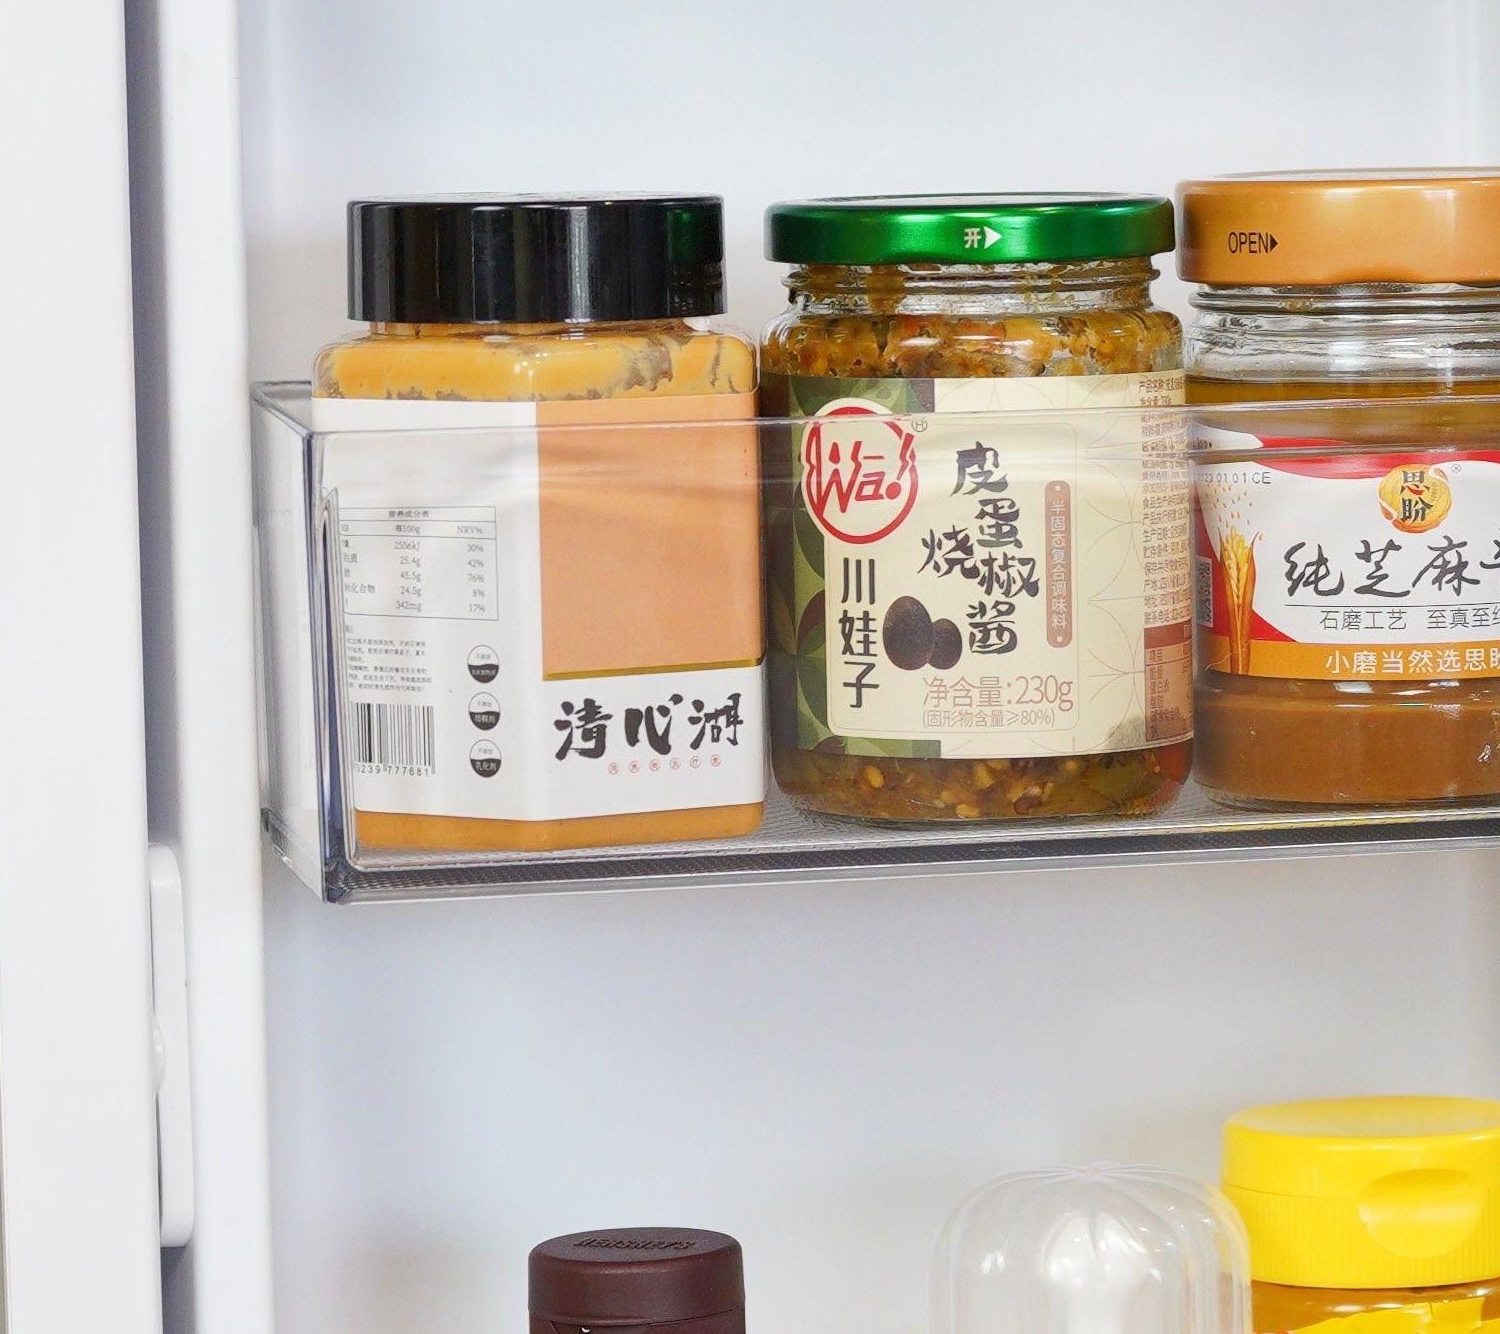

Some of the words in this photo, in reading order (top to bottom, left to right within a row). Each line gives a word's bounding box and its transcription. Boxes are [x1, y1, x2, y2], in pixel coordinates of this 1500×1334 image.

[963, 228, 982, 249] 开
[1228, 232, 1270, 255] OPEN
[1049, 499, 1069, 633] 半固态复合调味料
[838, 557, 880, 709] 川娃子
[1319, 608, 1408, 632] 石磨工艺
[922, 673, 1075, 713] 净含量:230g
